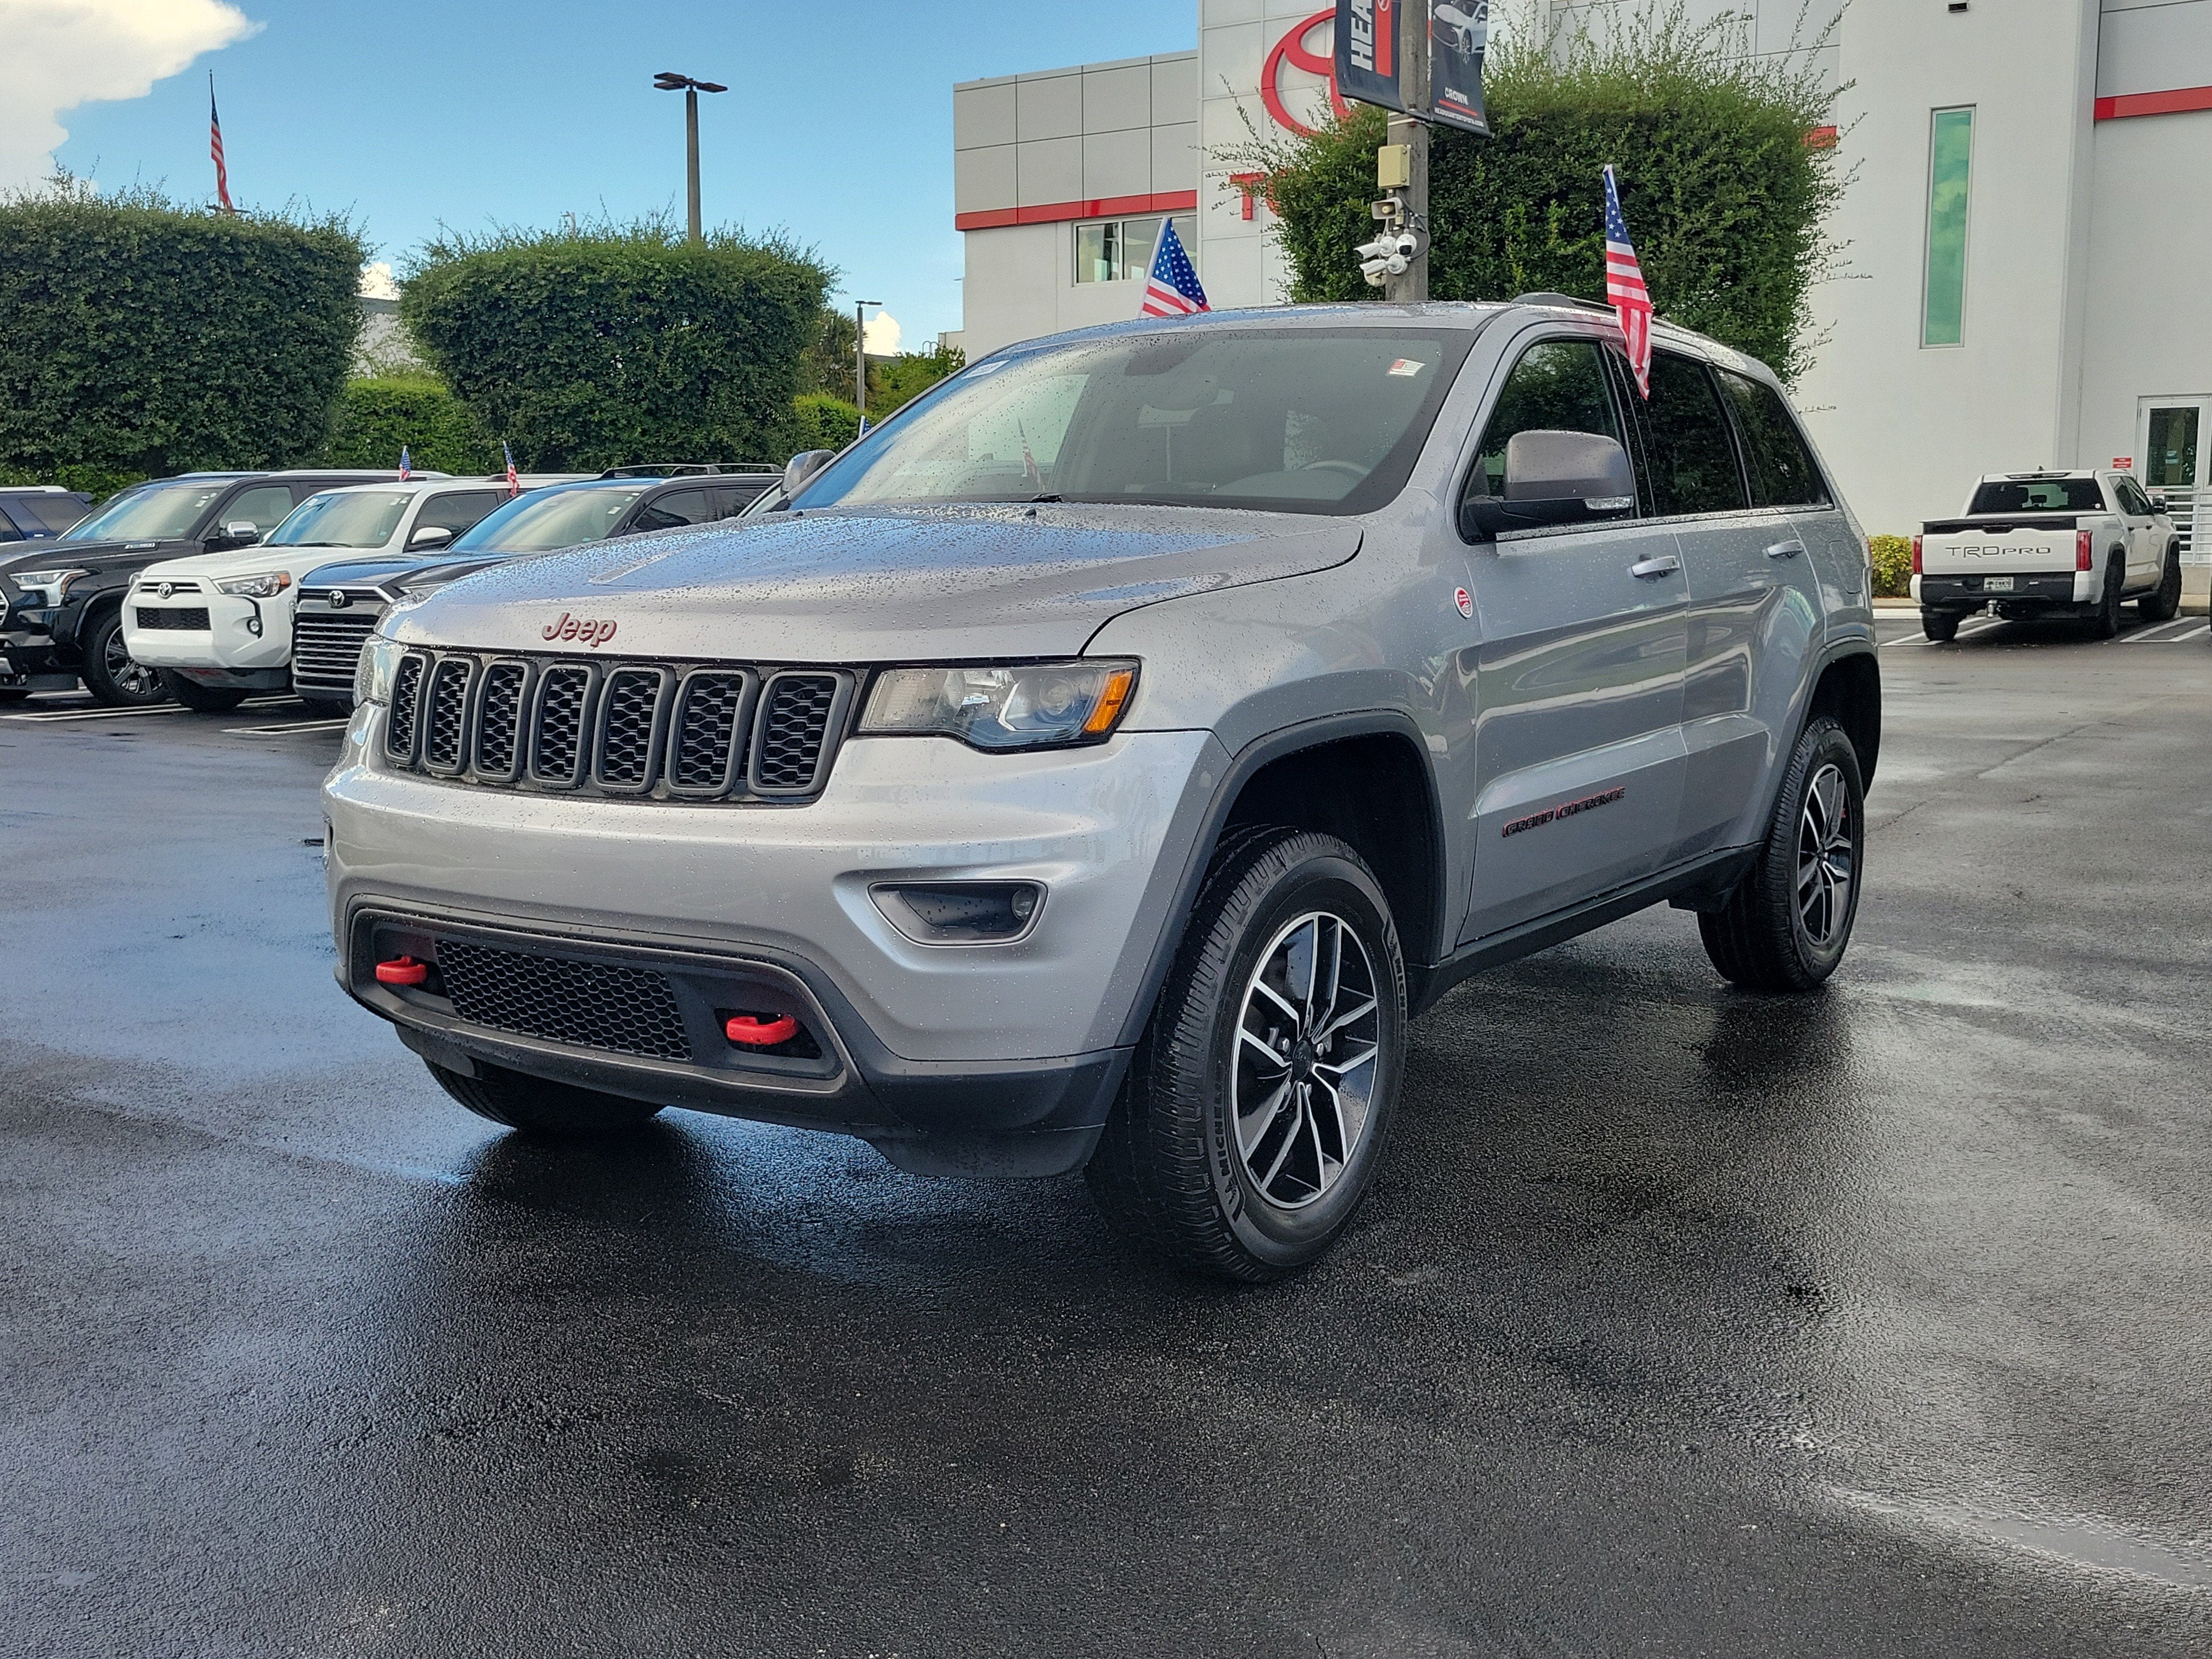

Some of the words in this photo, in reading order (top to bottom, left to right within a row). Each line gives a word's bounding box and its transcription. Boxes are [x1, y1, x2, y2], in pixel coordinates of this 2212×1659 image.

[1444, 87, 1469, 105] CROWN
[541, 612, 617, 648] Jeep
[1502, 808, 1554, 838] GRAND
[1556, 786, 1626, 820] CHEROKEE
